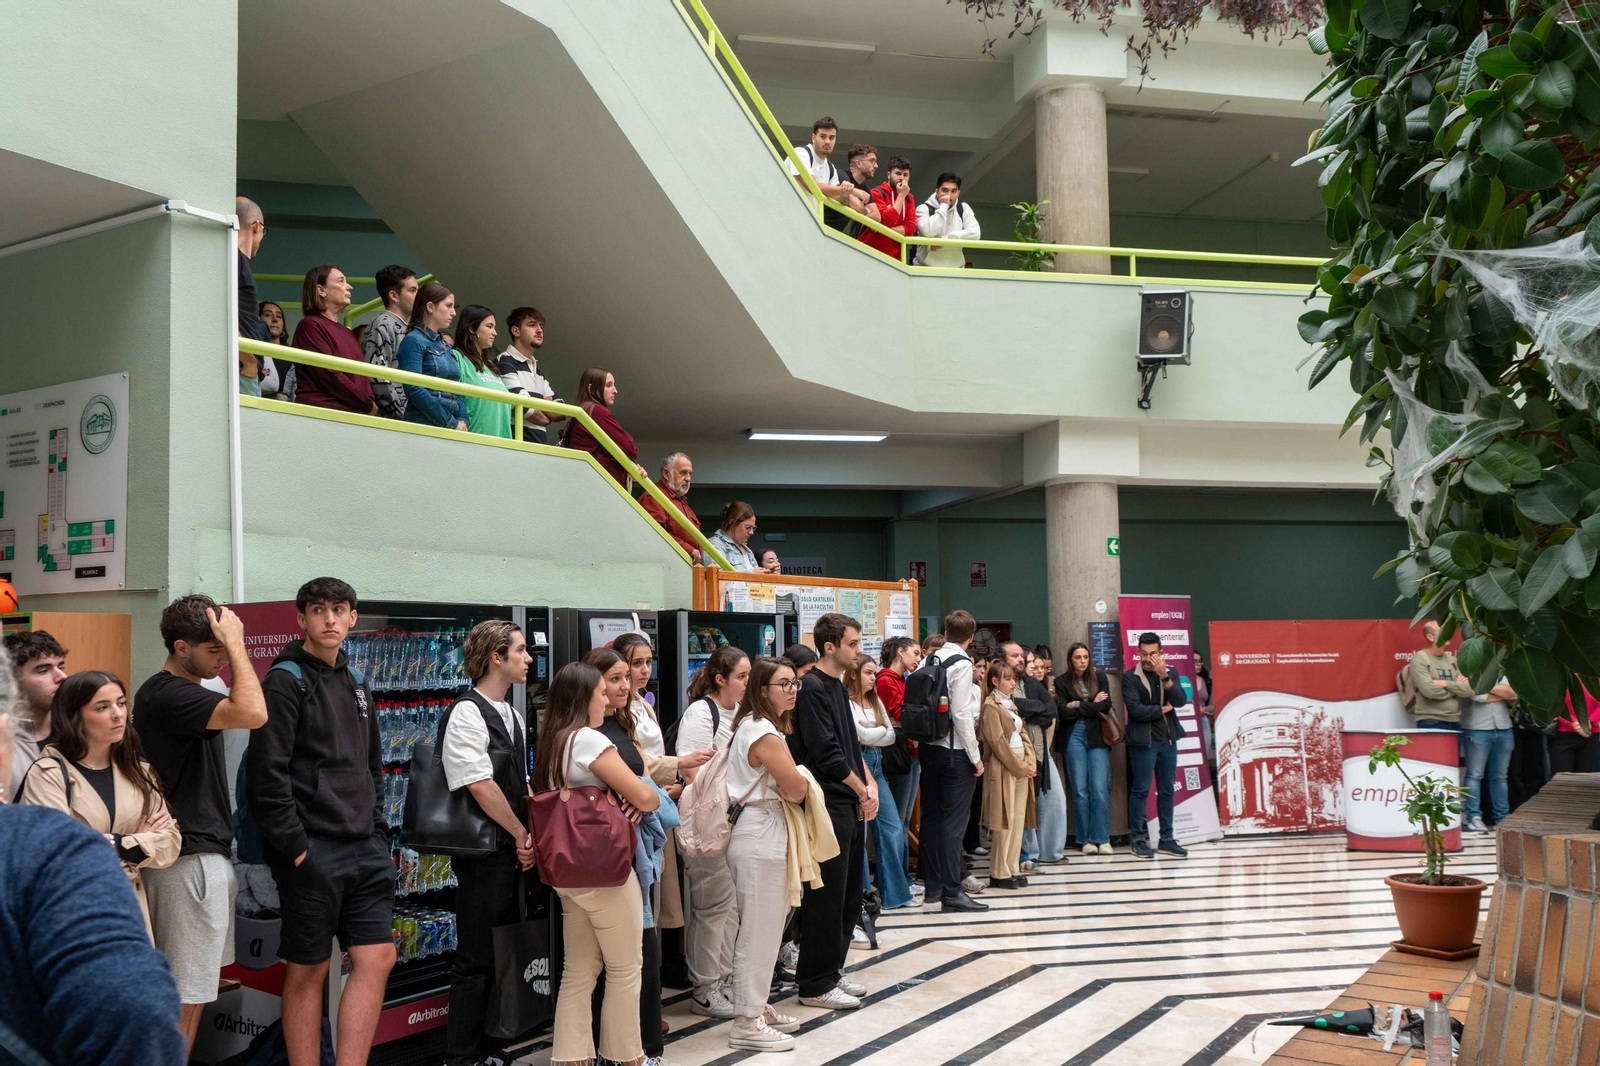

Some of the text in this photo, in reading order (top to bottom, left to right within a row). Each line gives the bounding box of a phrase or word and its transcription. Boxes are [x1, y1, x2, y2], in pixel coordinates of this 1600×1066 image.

[780, 566, 823, 575] IBLIOTECA
[243, 634, 300, 645] UNIVERSIDAD
[253, 647, 284, 659] GRAN
[1351, 783, 1418, 807] emple
